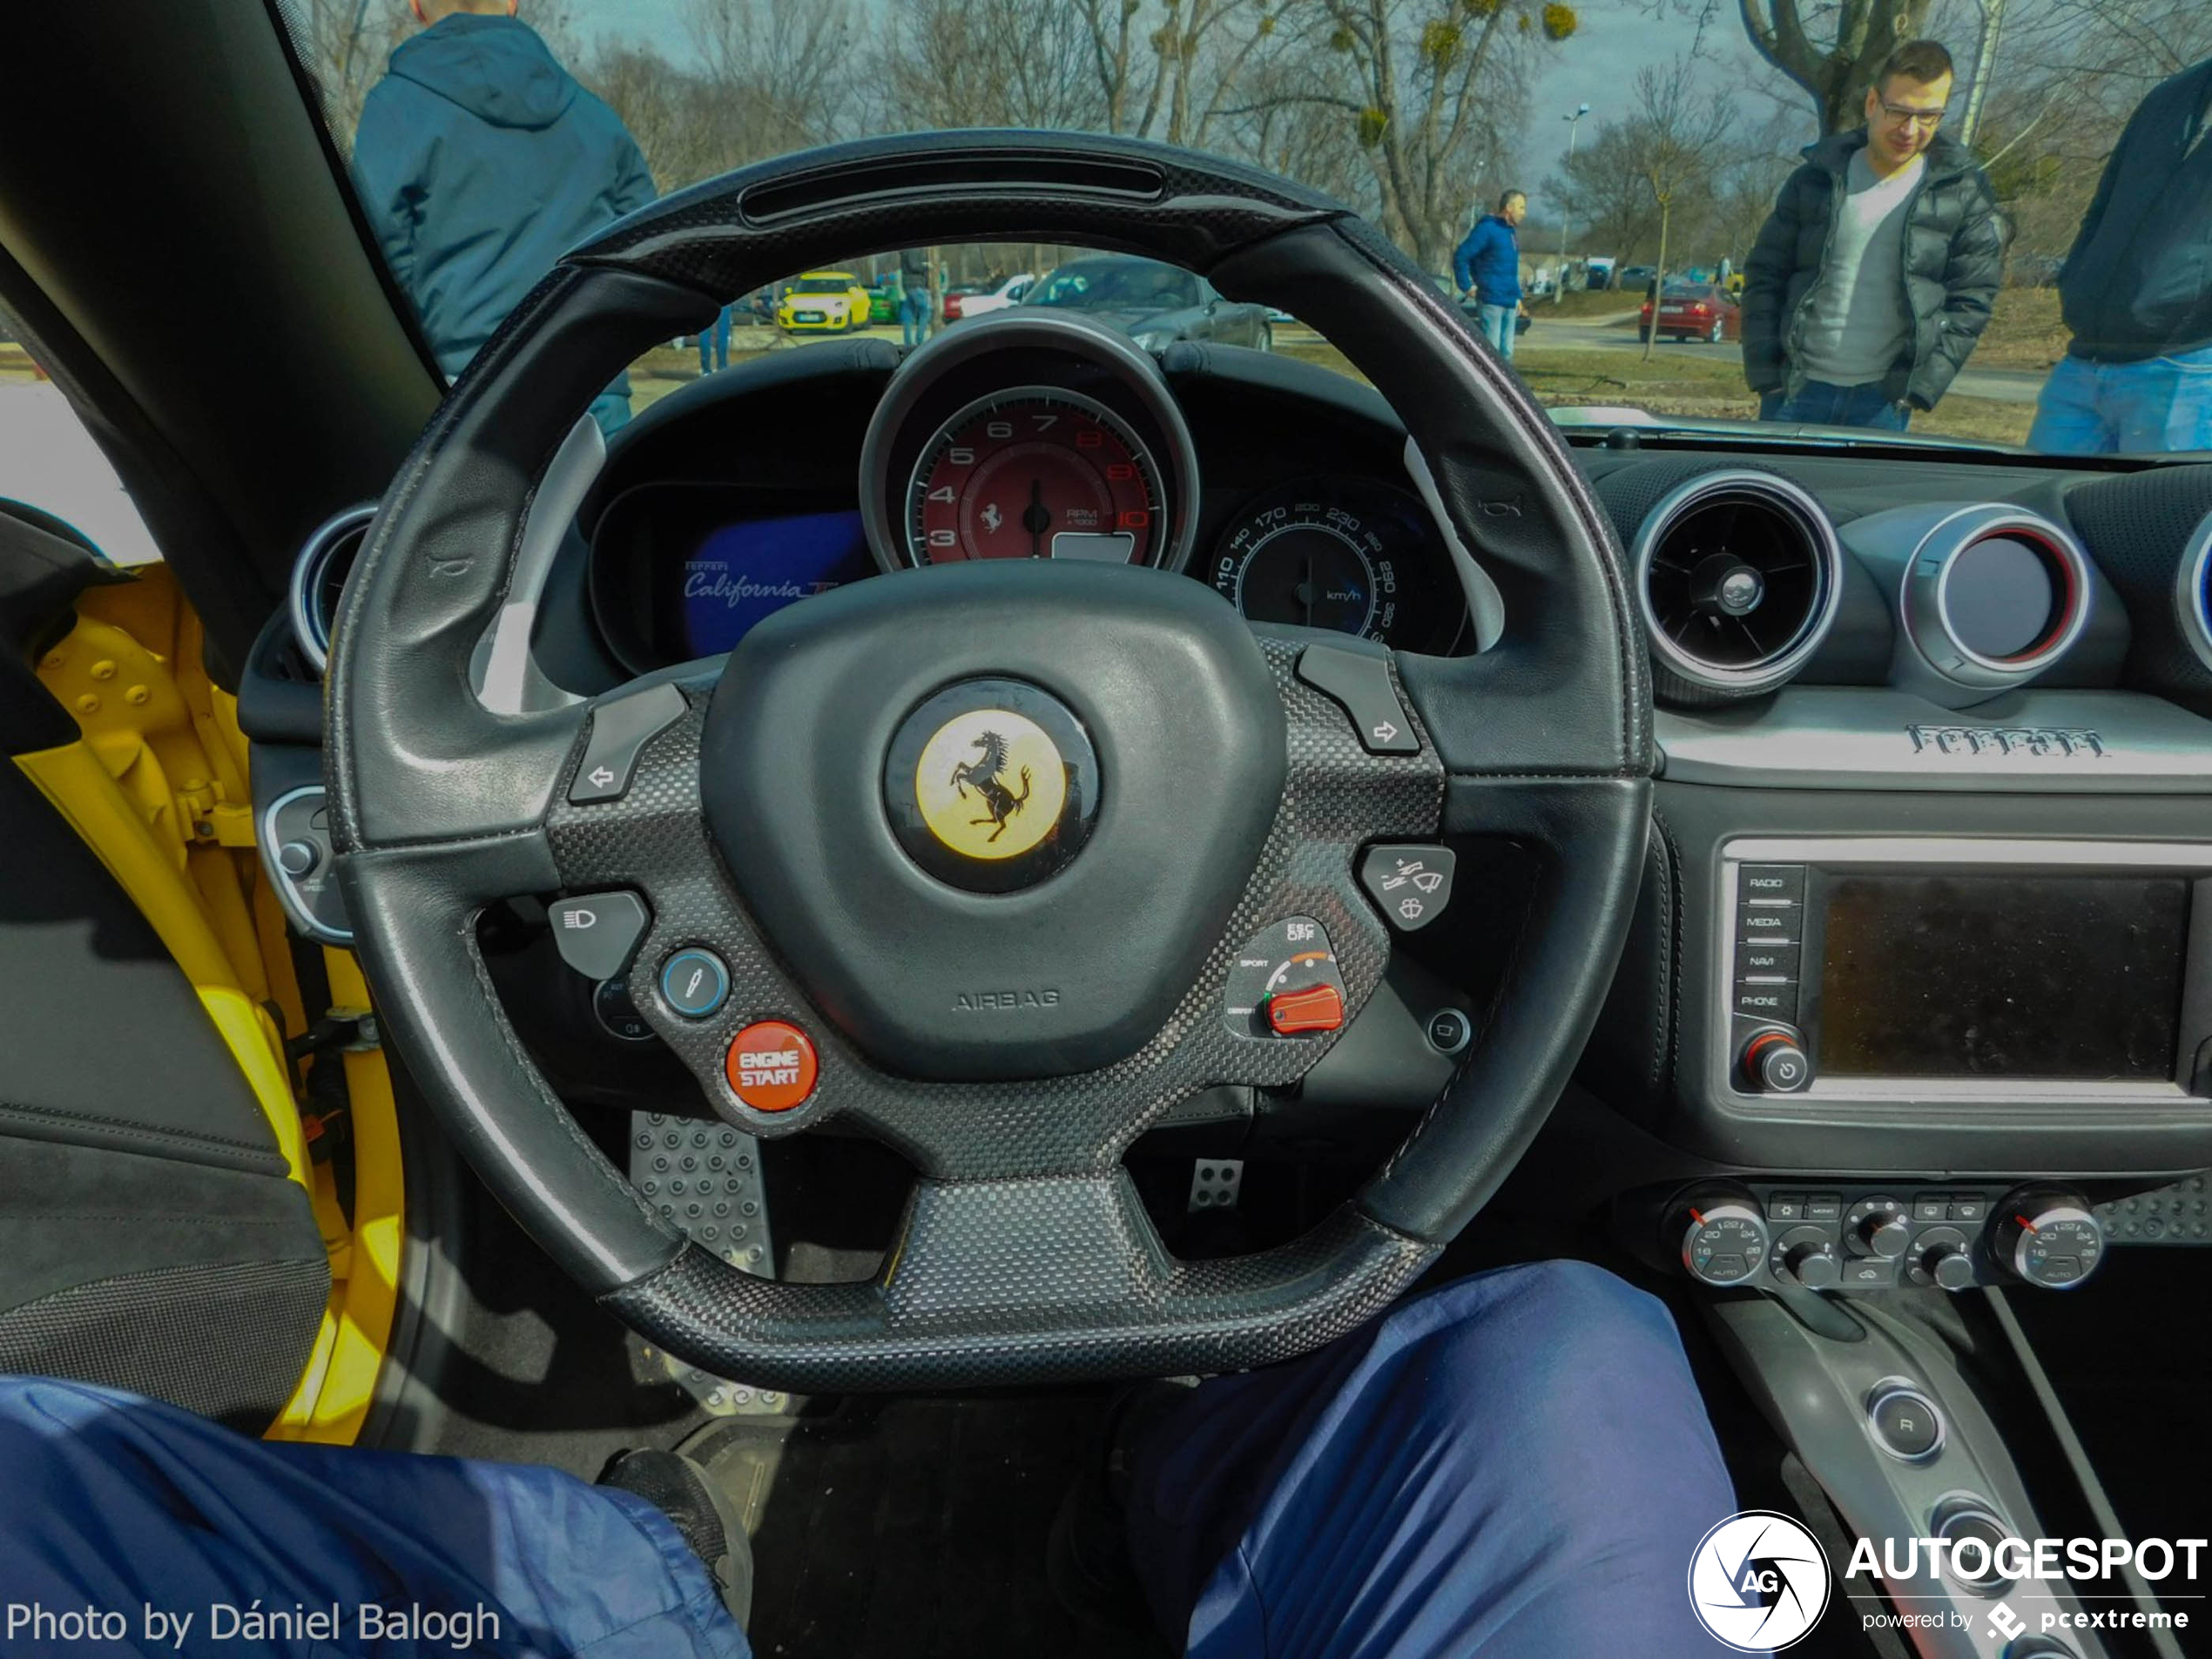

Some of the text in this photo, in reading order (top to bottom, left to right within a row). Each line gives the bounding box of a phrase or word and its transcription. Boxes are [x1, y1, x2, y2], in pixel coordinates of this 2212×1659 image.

[987, 421, 1013, 438] 6
[1032, 415, 1058, 432] 7
[949, 448, 974, 465] 5
[928, 485, 955, 504] 4
[1067, 509, 1097, 519] RPM
[1119, 511, 1149, 528] 10
[1255, 507, 1286, 527] 170
[1325, 508, 1360, 532] 230
[929, 529, 956, 547] 3
[1231, 528, 1250, 550] 140
[1217, 556, 1233, 590] 110
[1379, 561, 1396, 594] 290
[684, 571, 810, 608] California
[1326, 590, 1360, 601] km/h
[1904, 724, 2113, 758] Ferrari
[1750, 878, 1784, 887] RADIO
[1287, 923, 1315, 933] ESC
[1746, 917, 1782, 927] MEDIA
[1287, 932, 1315, 941] OFF
[1239, 959, 1269, 968] SPORT
[1750, 957, 1775, 966] NAVI
[950, 988, 1060, 1011] AIRBAG
[1741, 996, 1778, 1006] PHONE
[738, 1049, 799, 1069] ENGINE
[738, 1068, 799, 1087] START
[1723, 1220, 1740, 1230] 22
[1704, 1231, 1721, 1239] 20
[1740, 1230, 1756, 1239] 24
[2040, 1231, 2057, 1240] 20
[2076, 1231, 2092, 1241] 24
[1900, 1419, 1913, 1432] R
